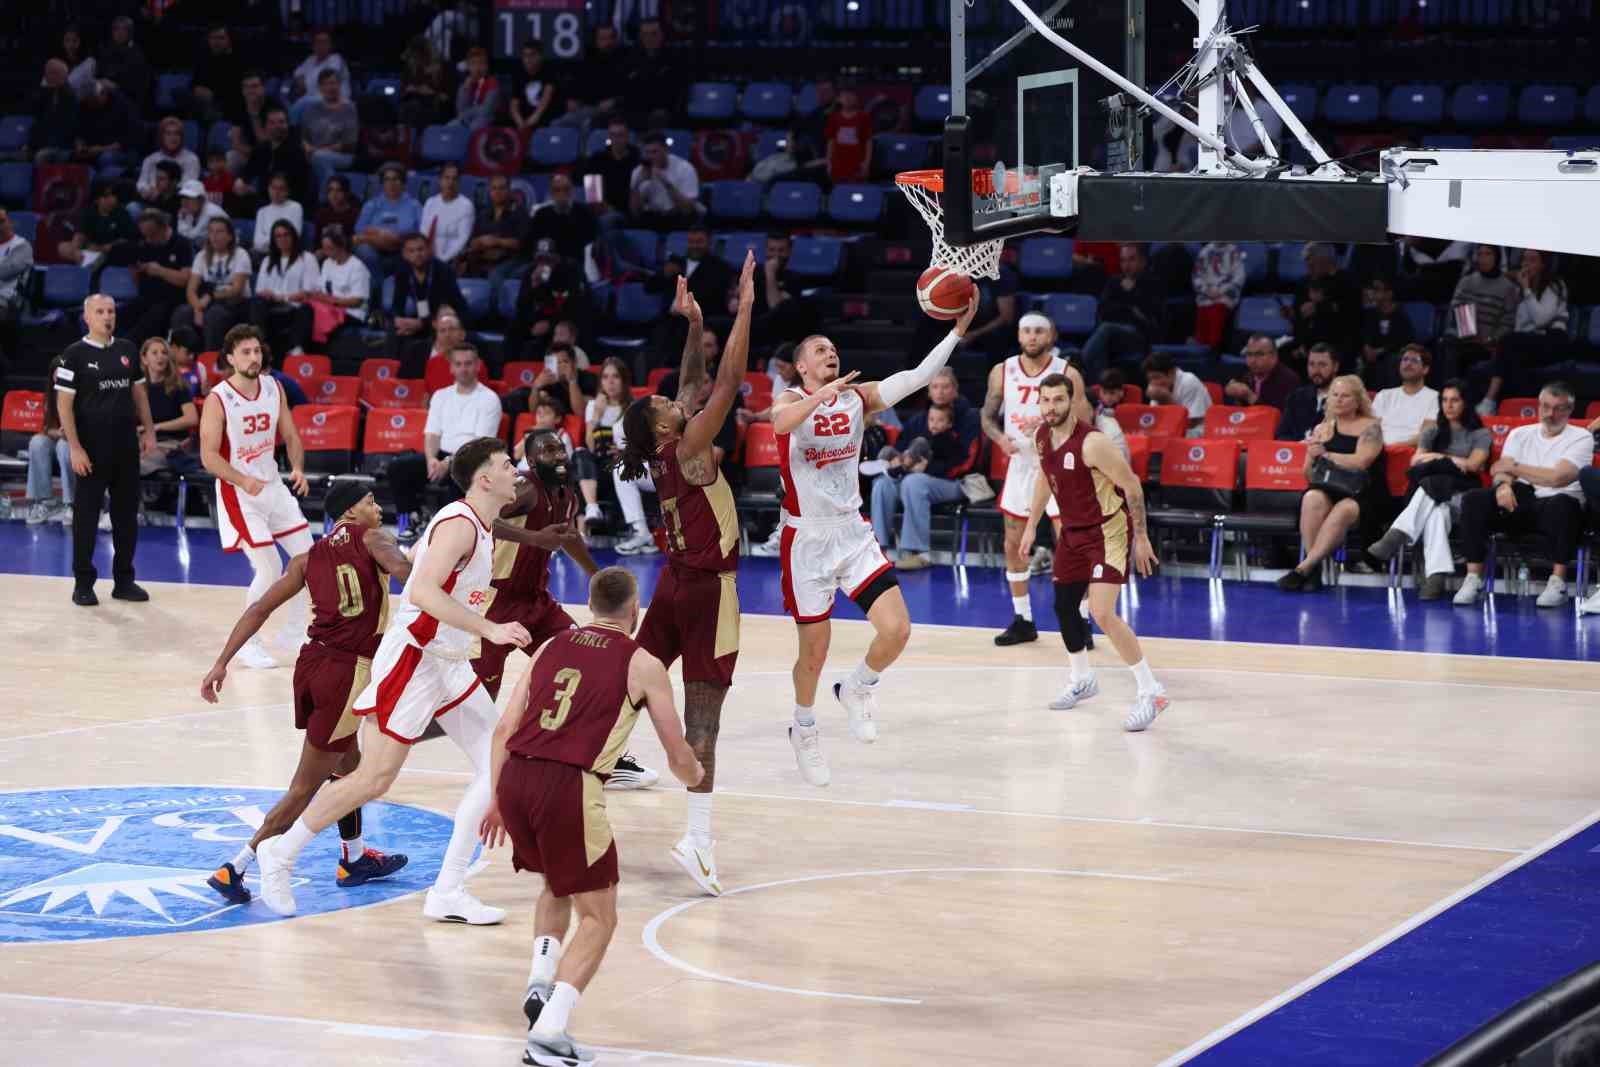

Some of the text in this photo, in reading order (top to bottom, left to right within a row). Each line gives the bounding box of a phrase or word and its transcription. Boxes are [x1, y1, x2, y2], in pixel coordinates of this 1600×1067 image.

[499, 12, 580, 57] 118
[243, 412, 271, 435] 33
[813, 412, 850, 436] 22
[335, 563, 365, 618] 0
[539, 667, 583, 731] 3
